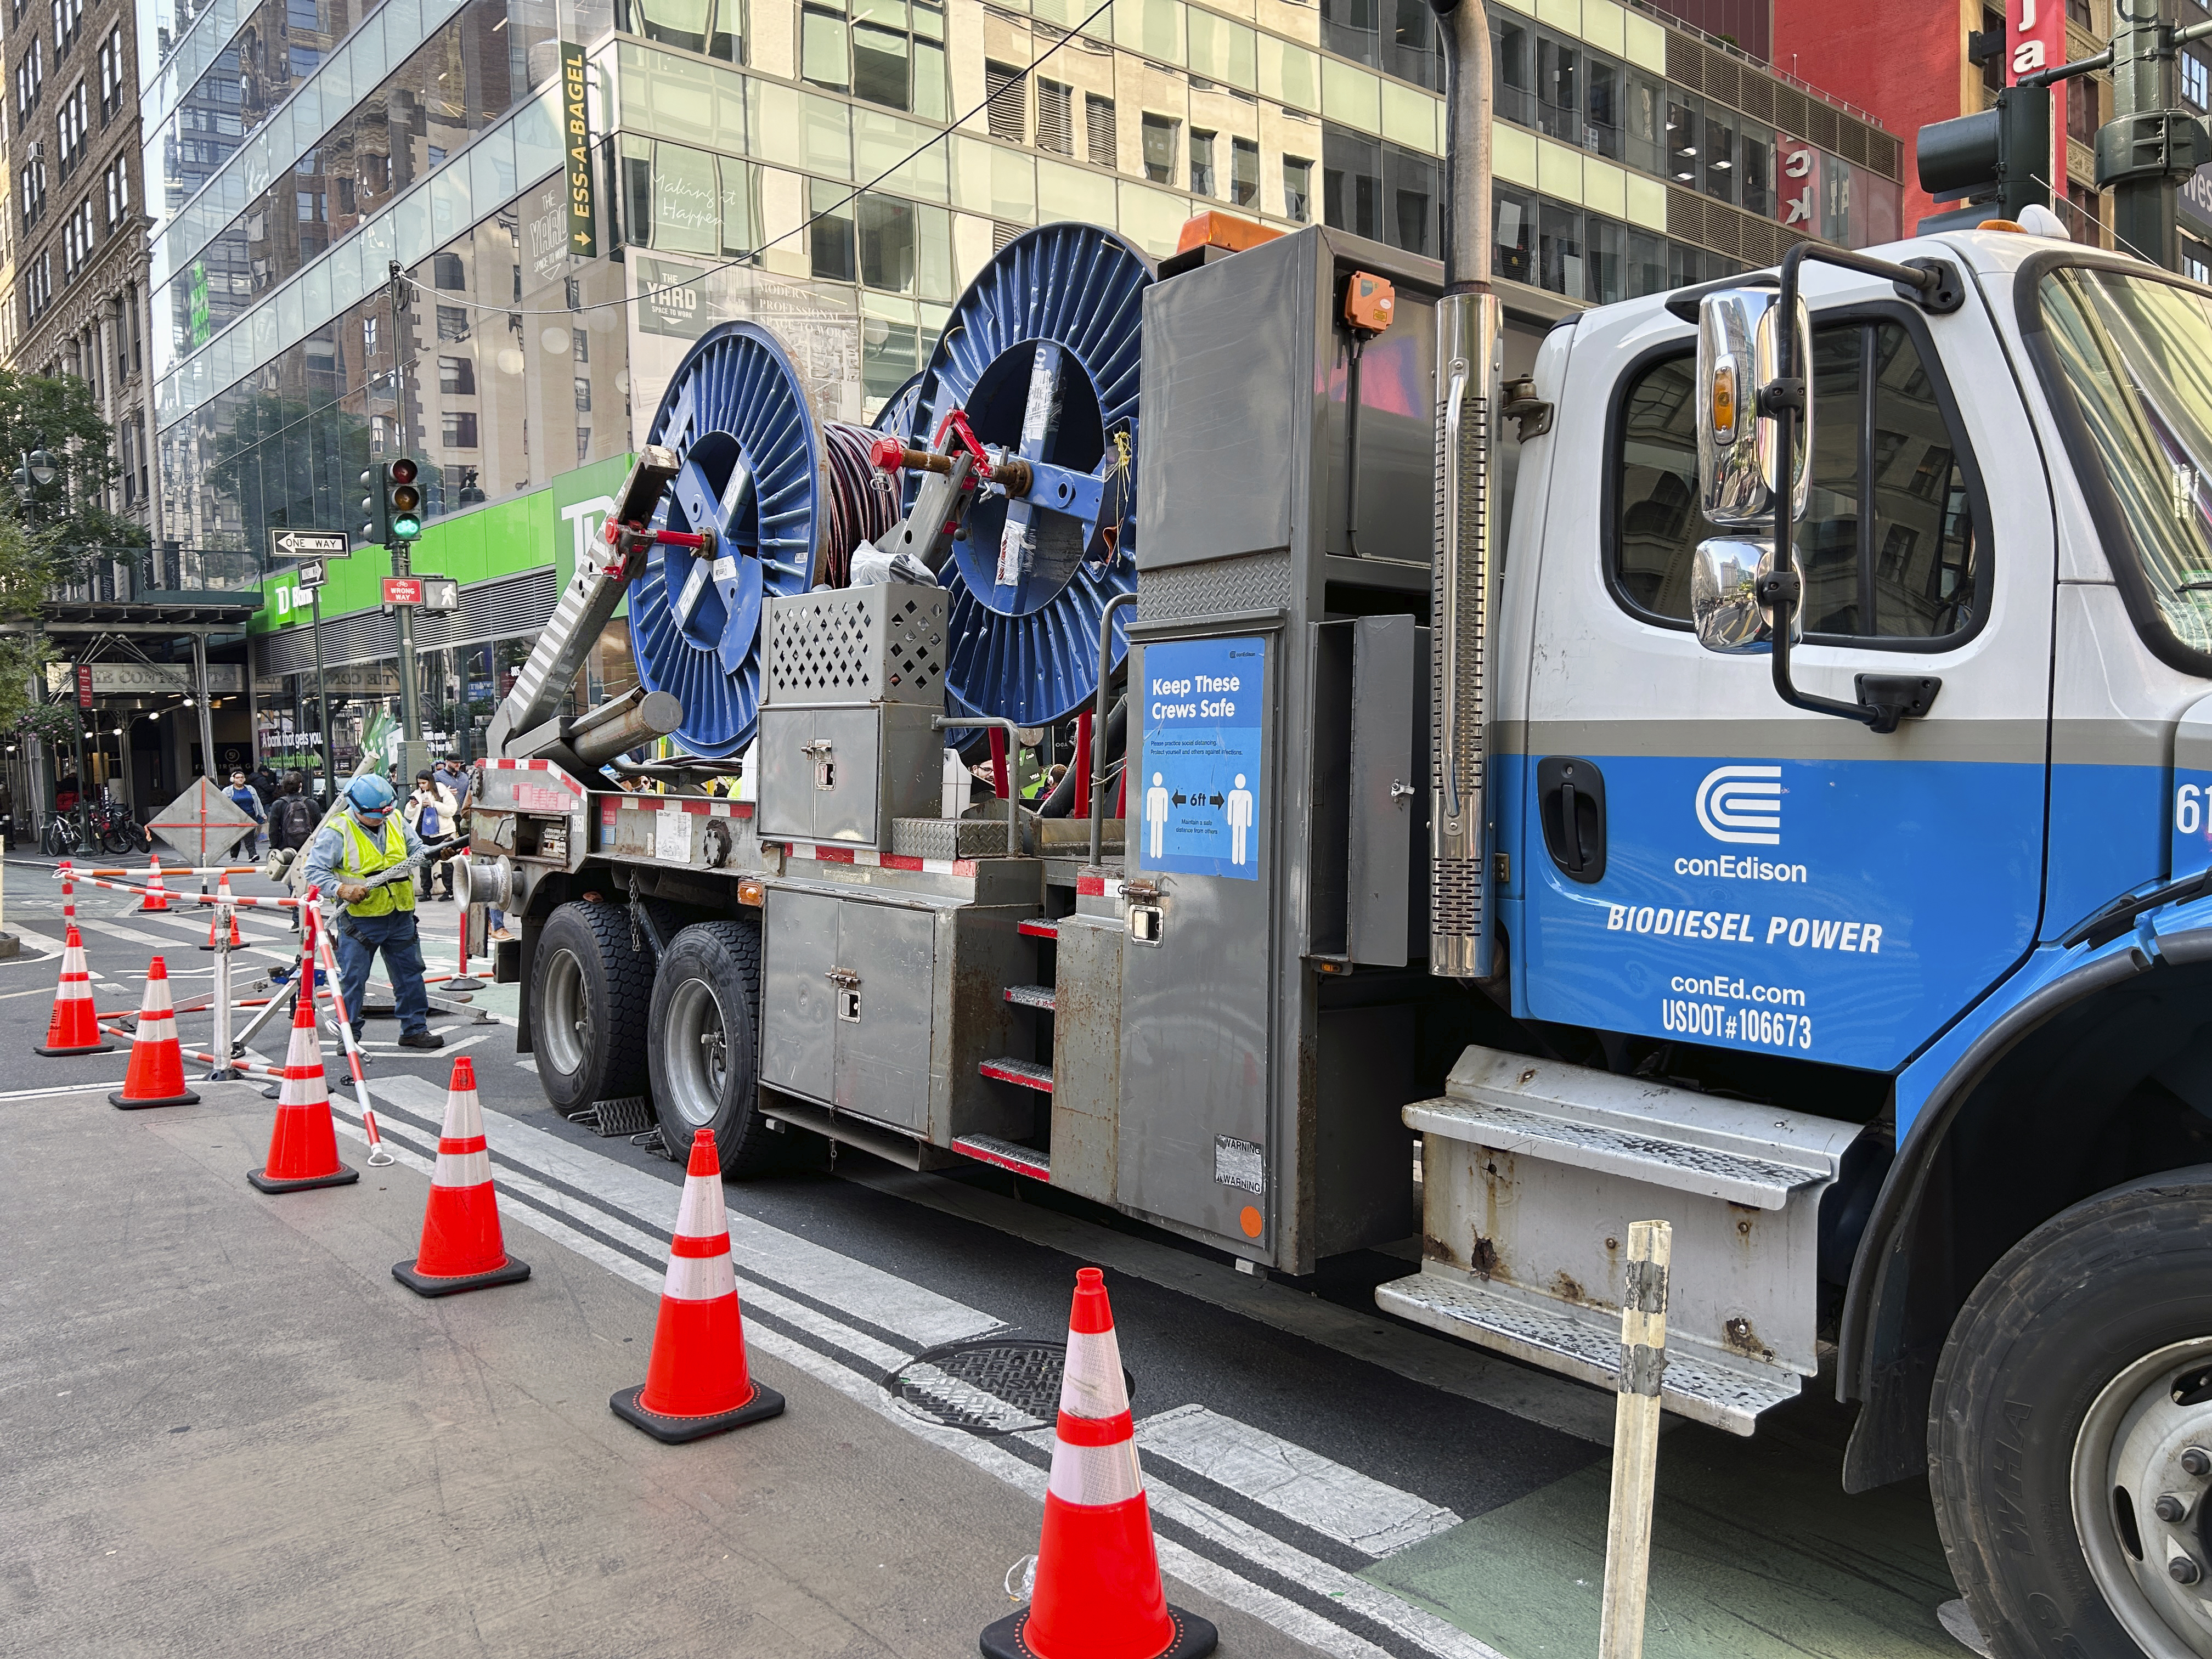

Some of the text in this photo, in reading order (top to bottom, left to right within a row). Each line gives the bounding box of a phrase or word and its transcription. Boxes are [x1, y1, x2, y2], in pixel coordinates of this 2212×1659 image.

[567, 54, 590, 218] ESS-A-BAGEL
[650, 168, 736, 208] Making it
[541, 189, 556, 211] THE
[662, 198, 725, 228] Happen
[530, 204, 568, 257] YARD
[534, 256, 549, 273] SPACE
[549, 251, 555, 265] TO
[662, 273, 678, 284] THE
[646, 281, 697, 310] YARD
[759, 281, 808, 300] MODERN
[652, 306, 668, 315] SPACE
[677, 309, 692, 319] WORK
[759, 298, 841, 321] PROFESSIONAL
[760, 315, 850, 339] SPACE TO WORK
[286, 538, 336, 548] ONE WAY
[275, 586, 289, 615] TD
[1153, 675, 1240, 698] Keep These
[1152, 698, 1235, 720] Crews Safe
[262, 731, 323, 749] A bank that gets you.
[1190, 793, 1206, 806] 6ft
[1674, 855, 1807, 883] conEdison
[1607, 905, 1883, 953] BIODIESEL POWER
[1671, 975, 1805, 1006] conEd.com
[1662, 998, 1812, 1049] USDOT#106673
[1224, 1138, 1261, 1155] WARNING
[1223, 1173, 1260, 1193] WARNING
[1992, 1399, 2033, 1556] WHA
